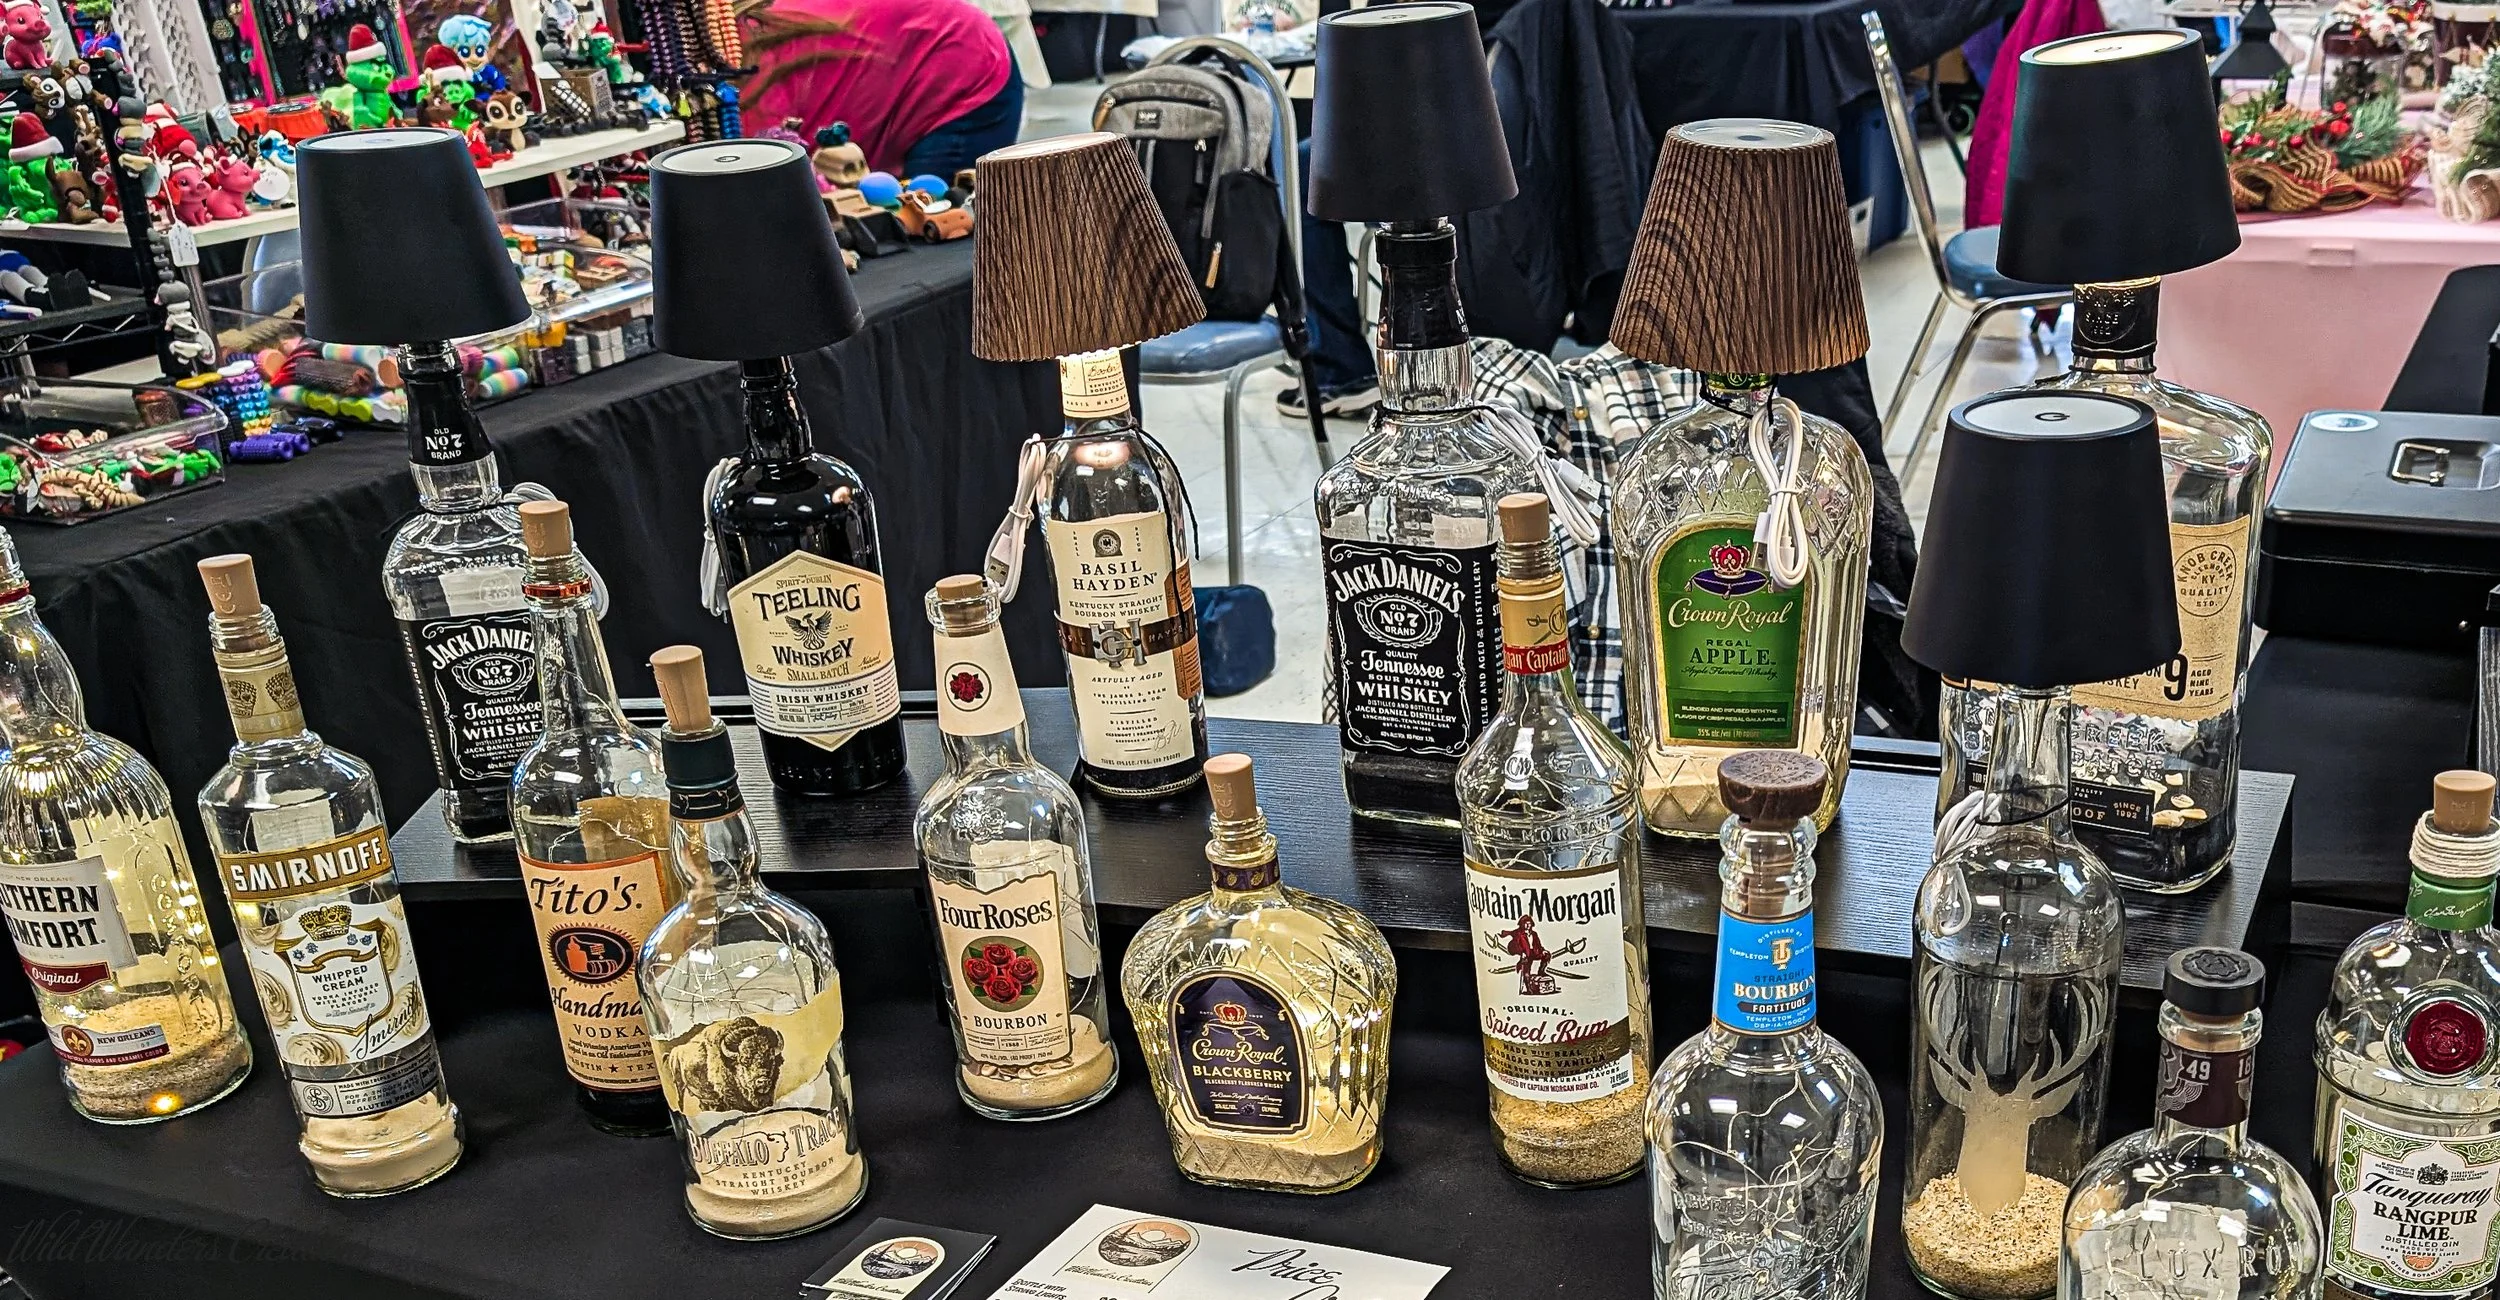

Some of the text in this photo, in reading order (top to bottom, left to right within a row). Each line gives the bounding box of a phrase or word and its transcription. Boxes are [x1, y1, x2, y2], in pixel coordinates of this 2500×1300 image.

[431, 450, 461, 460] BRAND
[1080, 560, 1142, 576] BASIL
[2177, 550, 2233, 583] KNOB CREEK
[776, 578, 800, 590] SPIRIT
[806, 574, 832, 584] DUBLIN
[1072, 573, 1156, 591] HAYDEN
[1331, 563, 1382, 603] JACK
[1380, 556, 1466, 613] DANIEL'S
[2202, 575, 2216, 584] KY
[2180, 585, 2230, 596] QUALITY
[752, 583, 861, 621] TEELING
[1068, 595, 1164, 610] KENTUCKY STRAIGHT
[1074, 604, 1161, 618] BOURBON WHISKEY
[1668, 597, 1794, 633] Crown Royal
[1407, 613, 1419, 628] 7
[1473, 560, 1487, 694] AND AGED DISTILLERY
[1385, 626, 1416, 636] BRAND
[425, 632, 472, 669] JACK
[1706, 639, 1752, 647] REGAL
[772, 637, 854, 667] WHISKEY
[1385, 650, 1418, 660] QUALITY
[1505, 645, 1568, 672] gan Captain
[1690, 648, 1770, 665] APPLE
[787, 668, 818, 681] SMALL
[820, 661, 849, 680] BATCH
[1361, 650, 1445, 678] Tennessee
[1681, 665, 1708, 677] Apple
[483, 677, 511, 685] BRAND
[1140, 672, 1163, 681] AGED
[1368, 674, 1439, 687] SOUR MASH
[2163, 654, 2188, 701] 9
[2191, 669, 2212, 677] AGED
[1147, 687, 1167, 695] BEAM
[2190, 679, 2209, 687] NINE
[776, 685, 869, 704] IRISH WHISKEY
[1356, 681, 1452, 705] WHISKEY
[2189, 687, 2214, 697] YEARS
[463, 702, 542, 720] Tennessee
[1355, 705, 1456, 722] JACK DANIEL DISTILLERY
[1368, 699, 1395, 707] DISTILLED
[1410, 704, 1434, 713] BOTTLED
[507, 714, 539, 722] MASH
[2073, 807, 2106, 820] OOF
[2113, 802, 2141, 812] SINCE
[2117, 810, 2137, 819] 1992
[230, 837, 382, 892] SMIRNOFF
[0, 882, 99, 912] UTHERN
[530, 876, 638, 915] Tito's
[1466, 872, 1616, 924] Captain Morgan
[938, 896, 1053, 930] Four Roses
[5, 914, 100, 948] OMFORT
[1758, 928, 1795, 943] DISTILLED
[1563, 955, 1599, 967] QUALITY
[1729, 948, 1769, 960] TEMPLETON
[31, 967, 82, 986] Original
[312, 965, 368, 984] WHIPPED
[1754, 968, 1805, 983] STRAIGHT
[322, 976, 364, 992] CREAM
[344, 983, 379, 996] INFUSED
[1734, 975, 1815, 1000] BOURBON
[341, 988, 378, 1002] NATURAL
[551, 987, 643, 1018] Handma
[331, 998, 367, 1009] FLAVORS
[1507, 1006, 1567, 1016] ORIGINAL
[1752, 997, 1807, 1013] FORTITUDE
[974, 1013, 1048, 1030] BOURBON
[1485, 1007, 1611, 1045] Spiced Rum
[117, 1029, 156, 1041] ORLEANS
[573, 1023, 645, 1038] VODKA
[1192, 1039, 1284, 1064] Crown Royal
[1503, 1044, 1527, 1055] MADE
[1556, 1055, 1606, 1068] VANILLA
[2185, 1059, 2210, 1080] 49
[1192, 1065, 1292, 1082] BLACKBERRY
[1585, 1067, 1620, 1080] FLAVORS
[1527, 1083, 1550, 1092] CAPTAIN
[1550, 1084, 1575, 1092] MORGAN
[1576, 1082, 1588, 1091] RUM
[357, 1100, 392, 1112] GLUTEN
[686, 1107, 844, 1167] BUFFALO TRACE
[716, 1157, 834, 1189] STRAIGHT BOURBON
[743, 1161, 807, 1179] KENTUCKY
[751, 1179, 806, 1195] WHISKEY
[2363, 1172, 2493, 1208] Tanqueray
[2373, 1200, 2478, 1225] RANGPUR
[2398, 1223, 2450, 1240] LIME
[2385, 1235, 2438, 1248] DISTILLED
[1231, 1248, 1342, 1284] Price
[2391, 1260, 2453, 1277] OTHER BOTANICALS
[1005, 1285, 1067, 1300] STRING LIGHTS
[1011, 1278, 1067, 1292] BOTTLE WITH
